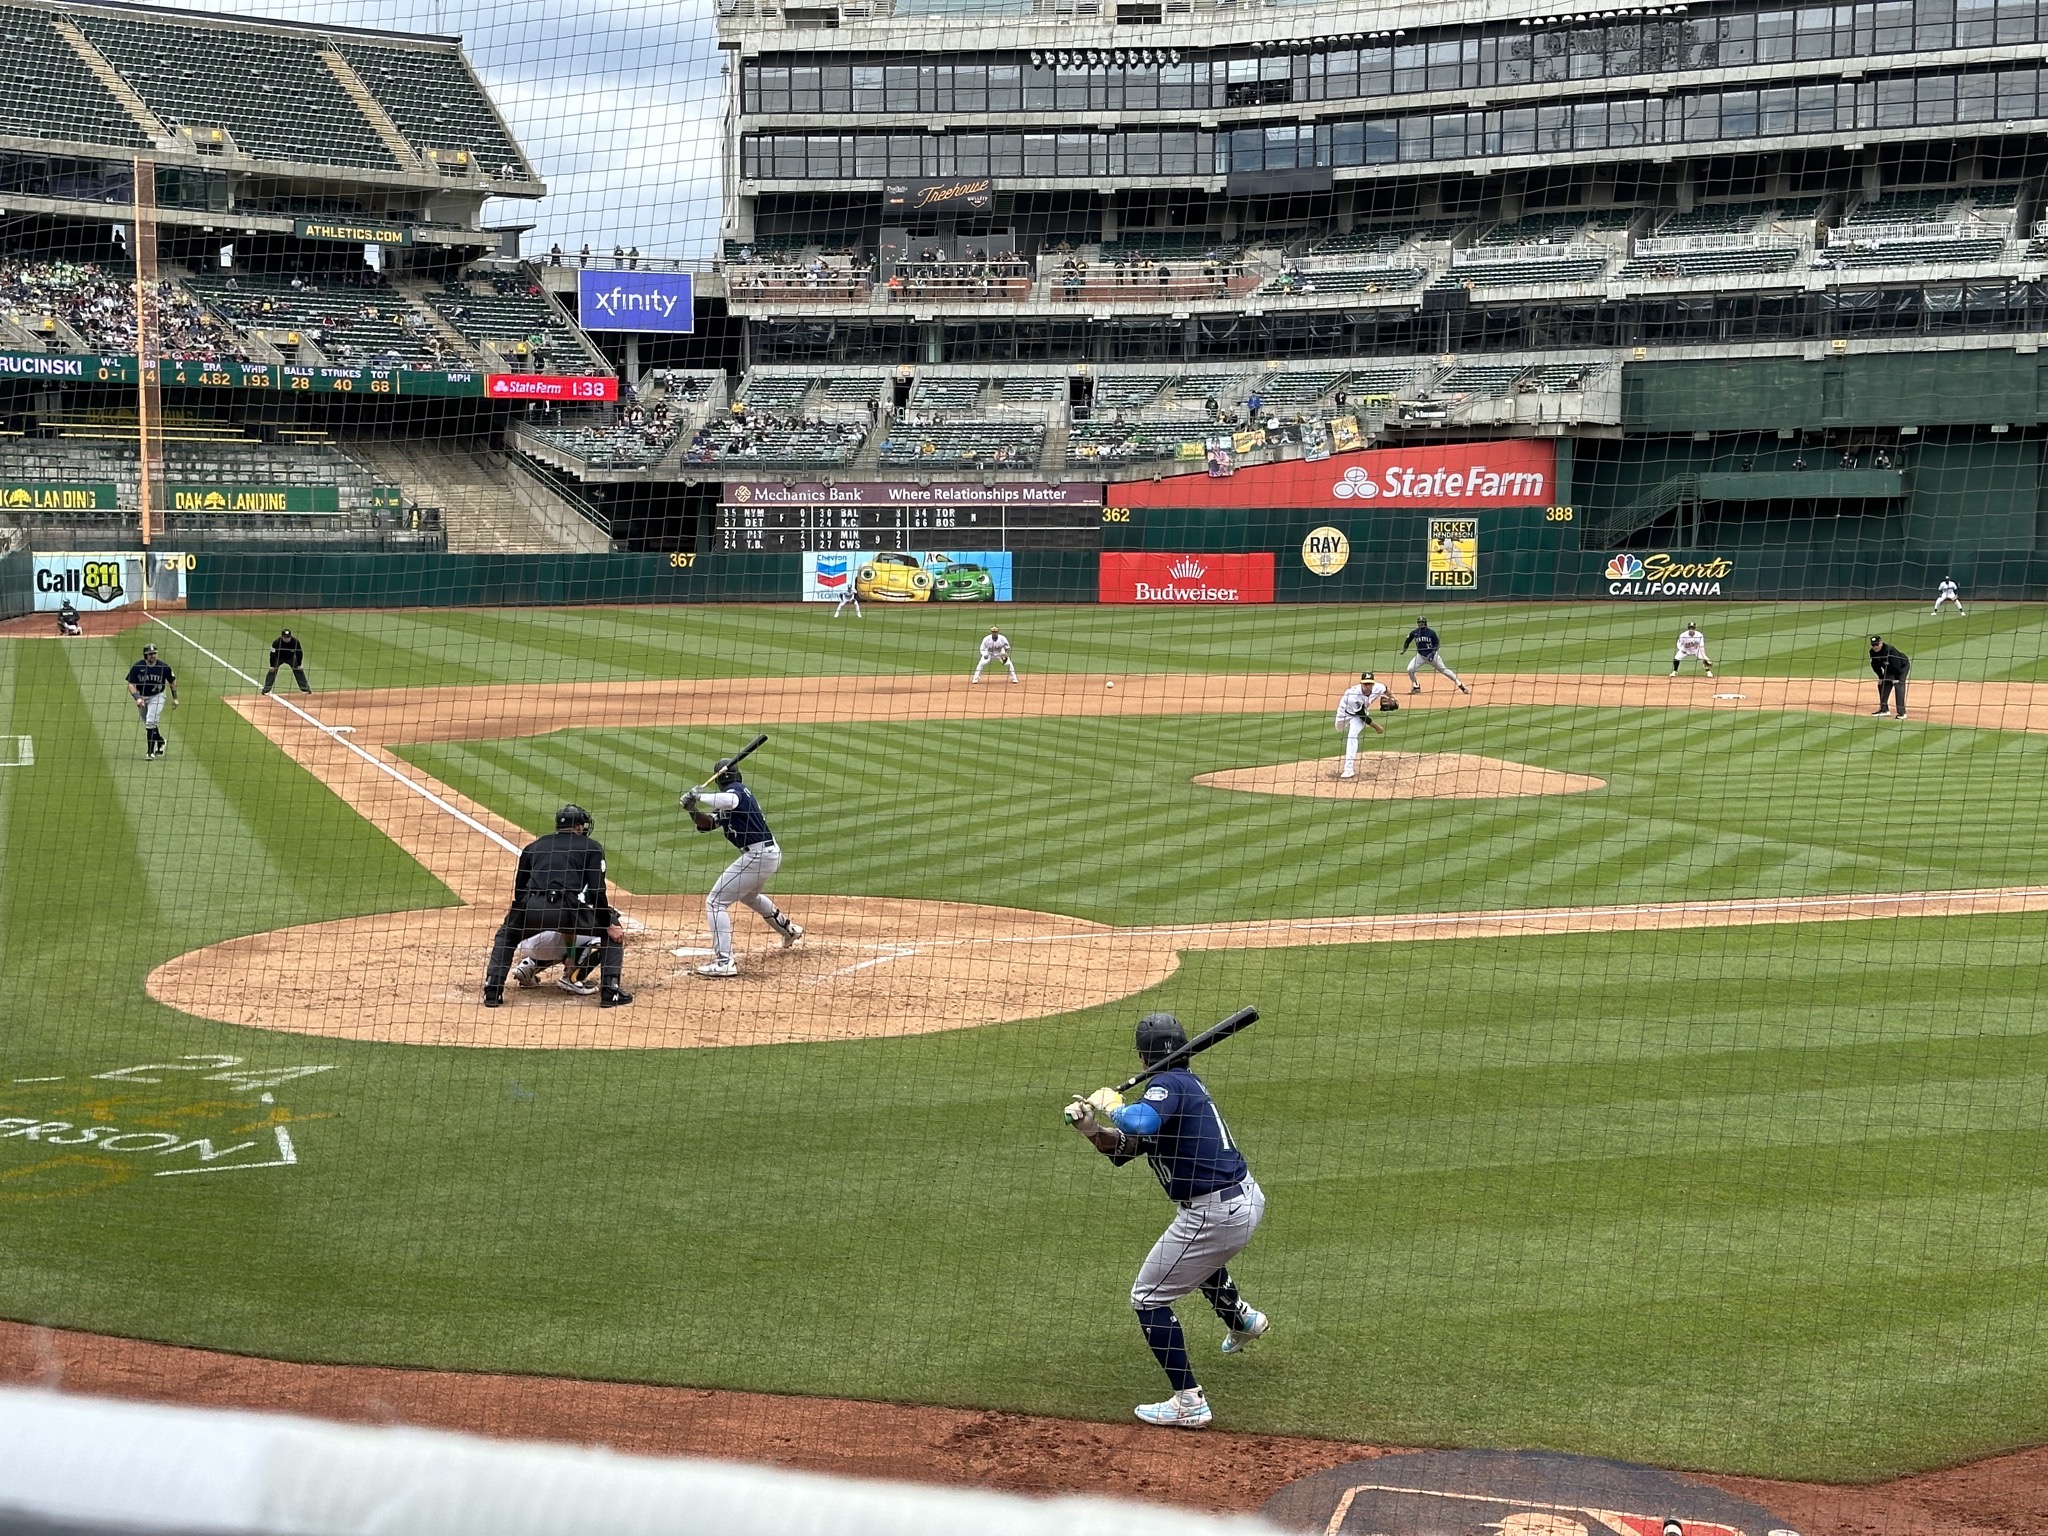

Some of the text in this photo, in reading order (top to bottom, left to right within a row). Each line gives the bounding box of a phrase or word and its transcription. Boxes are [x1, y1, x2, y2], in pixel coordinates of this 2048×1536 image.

[914, 180, 989, 208] Treehouse
[306, 225, 402, 243] ATHLETICS.COM
[595, 286, 678, 318] xfinity
[0, 356, 82, 375] RUCINSKI
[101, 358, 121, 367] W-L
[176, 362, 183, 370] K
[203, 363, 222, 372] ERA
[241, 364, 268, 374] WHIP
[283, 366, 315, 377] BALLS
[321, 368, 362, 379] STRIKES
[370, 370, 390, 380] TOT
[145, 372, 156, 383] 4
[176, 372, 186, 384] 4
[198, 373, 231, 386] 4.82
[291, 377, 310, 389] 28
[448, 373, 471, 383] MPH
[333, 379, 353, 391] 40
[370, 380, 390, 392] 68
[572, 382, 605, 396] 1:38
[34, 490, 96, 509] LANDING
[754, 487, 864, 501] Mechanics Bank
[888, 488, 1067, 502] Where Relationships Matter
[175, 492, 286, 510] OAK LANDING
[744, 508, 765, 517] NYM
[840, 508, 859, 518] BAL
[936, 508, 956, 518] TOR
[1102, 508, 1130, 523] 362
[1546, 507, 1574, 522] 388
[745, 518, 764, 527] DET
[800, 519, 806, 527] 2
[841, 518, 859, 527] K.C.
[935, 518, 956, 528] BOS
[1433, 522, 1473, 532] RICKEY
[746, 530, 763, 539] PIT
[840, 530, 859, 540] MIN
[895, 530, 901, 540] 2
[746, 540, 764, 550] T.B.
[839, 540, 861, 549] CWS
[895, 540, 901, 549] 2
[1310, 536, 1341, 553] RAY
[669, 553, 697, 567] 367
[817, 554, 848, 562] Chevron
[1644, 553, 1733, 584] Sports
[37, 568, 80, 592] Call
[85, 563, 120, 588] 811
[1431, 572, 1472, 586] FIELD
[1134, 582, 1239, 601] Budweiser
[1609, 582, 1721, 596] CALIFORNIA
